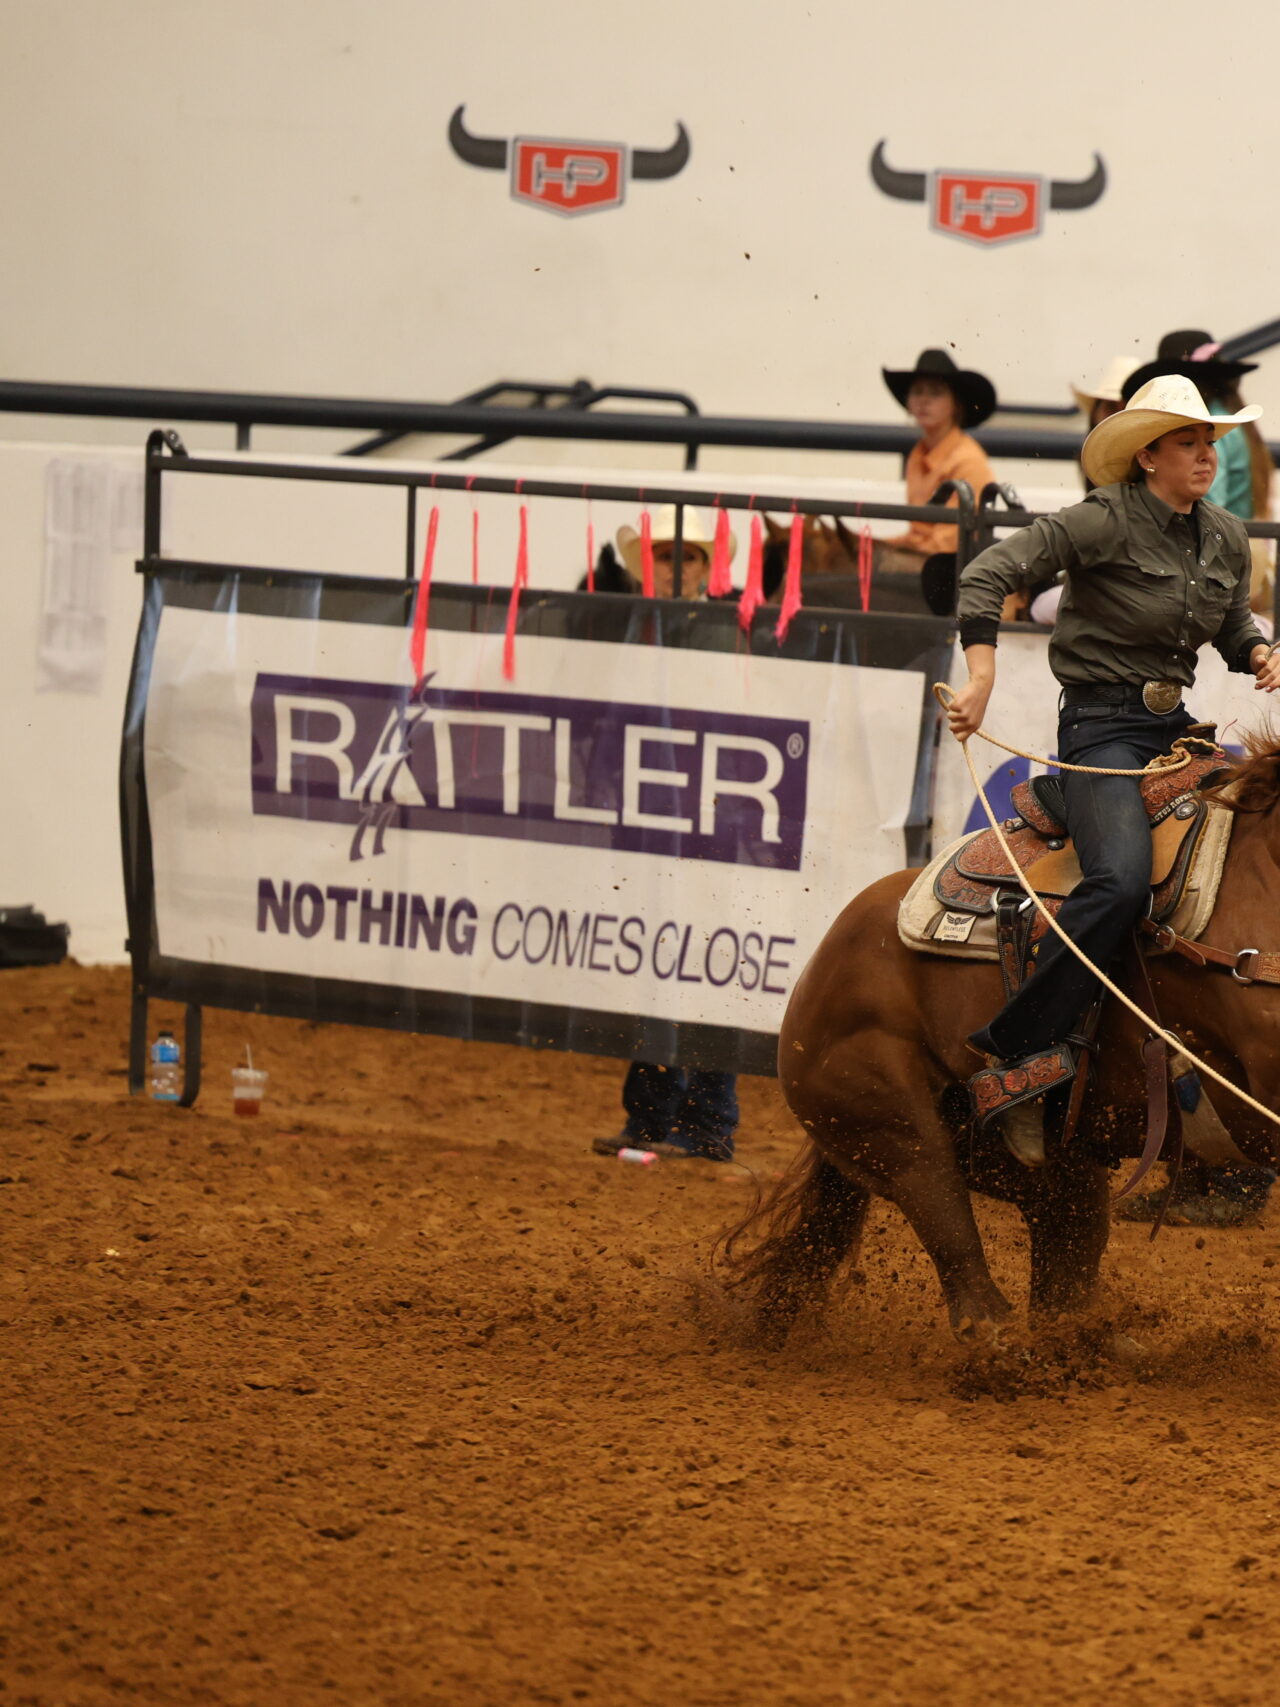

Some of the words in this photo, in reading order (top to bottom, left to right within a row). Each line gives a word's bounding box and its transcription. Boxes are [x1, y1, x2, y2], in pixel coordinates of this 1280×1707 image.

[532, 152, 609, 198] HP
[950, 184, 1028, 230] HP
[256, 877, 479, 957] NOTHING
[491, 901, 646, 976] COMES
[652, 919, 797, 995] CLOSE
